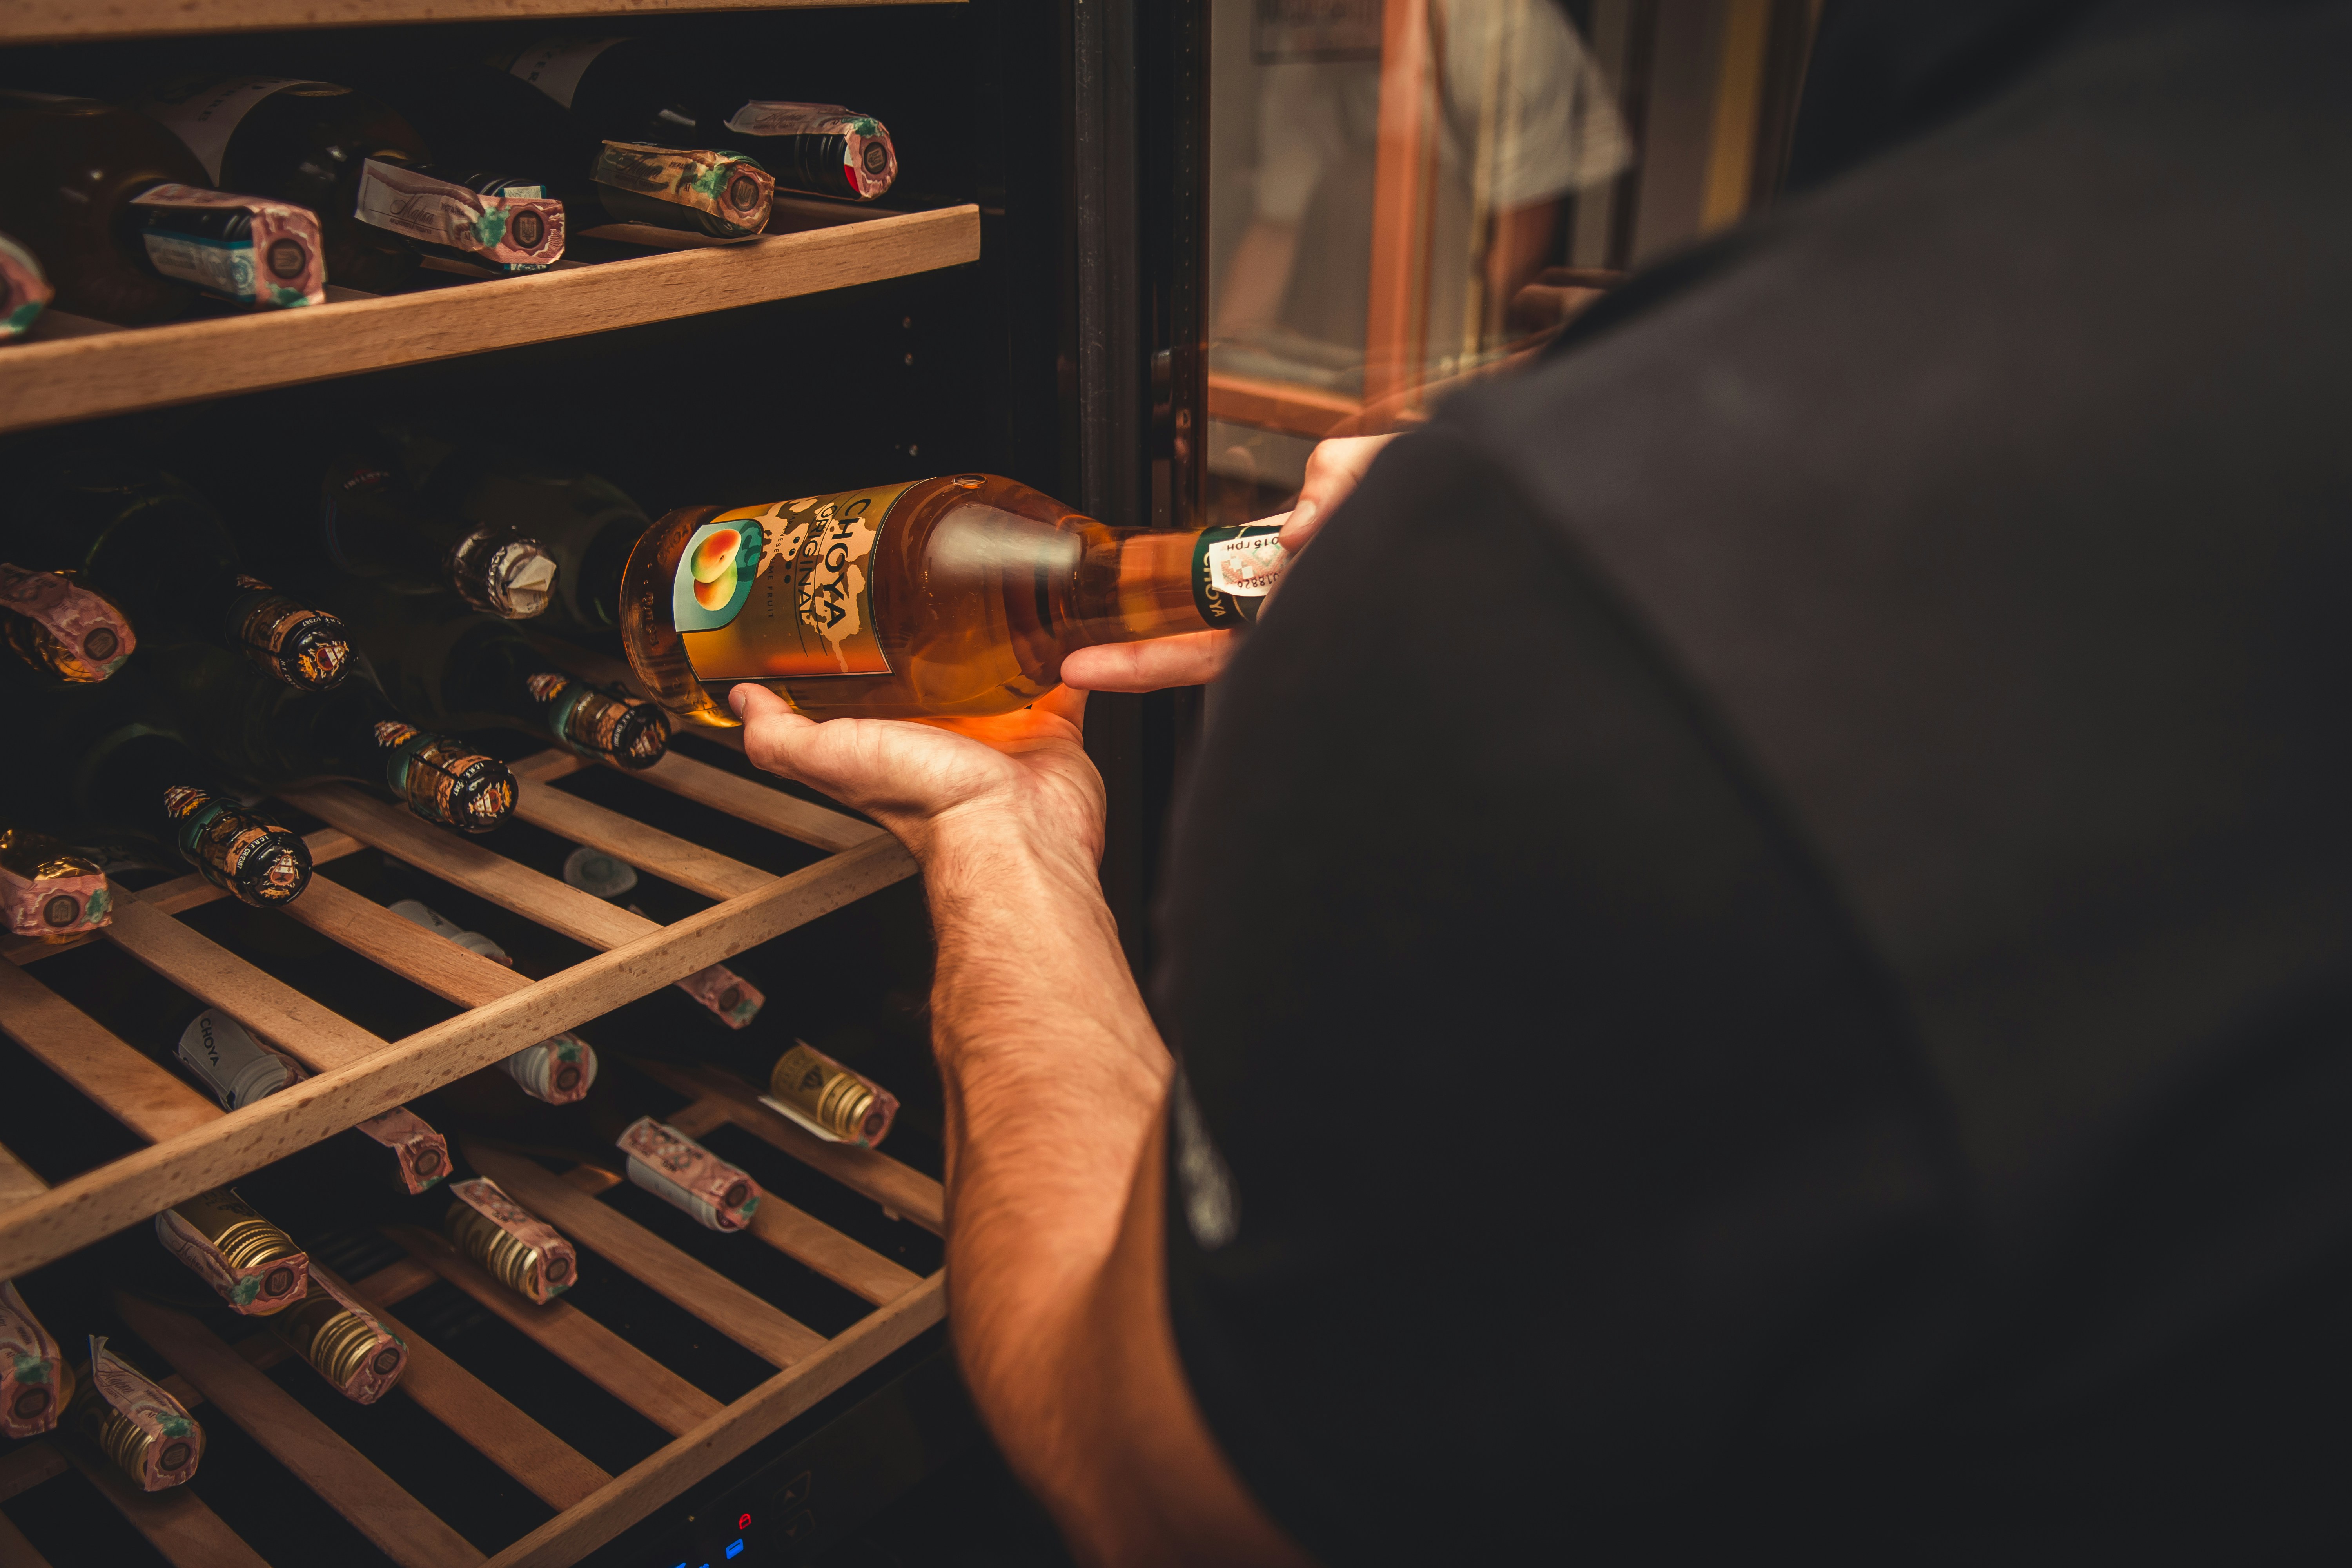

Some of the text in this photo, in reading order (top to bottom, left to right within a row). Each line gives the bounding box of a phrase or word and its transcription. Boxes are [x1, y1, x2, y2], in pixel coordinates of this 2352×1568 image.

[668, 161, 693, 171] УКРАЇНА
[440, 202, 465, 218] УКРАЇНА
[773, 513, 799, 554] JAPANESE
[1227, 540, 1250, 552] грн
[768, 558, 776, 581] UME
[798, 505, 838, 626] ORIGINAL
[823, 498, 871, 630] CHOYA
[237, 835, 269, 869] I.C.R.F. CR/2387
[200, 1017, 219, 1067] CHOYA
[145, 1389, 167, 1407] УКРАЇНА
